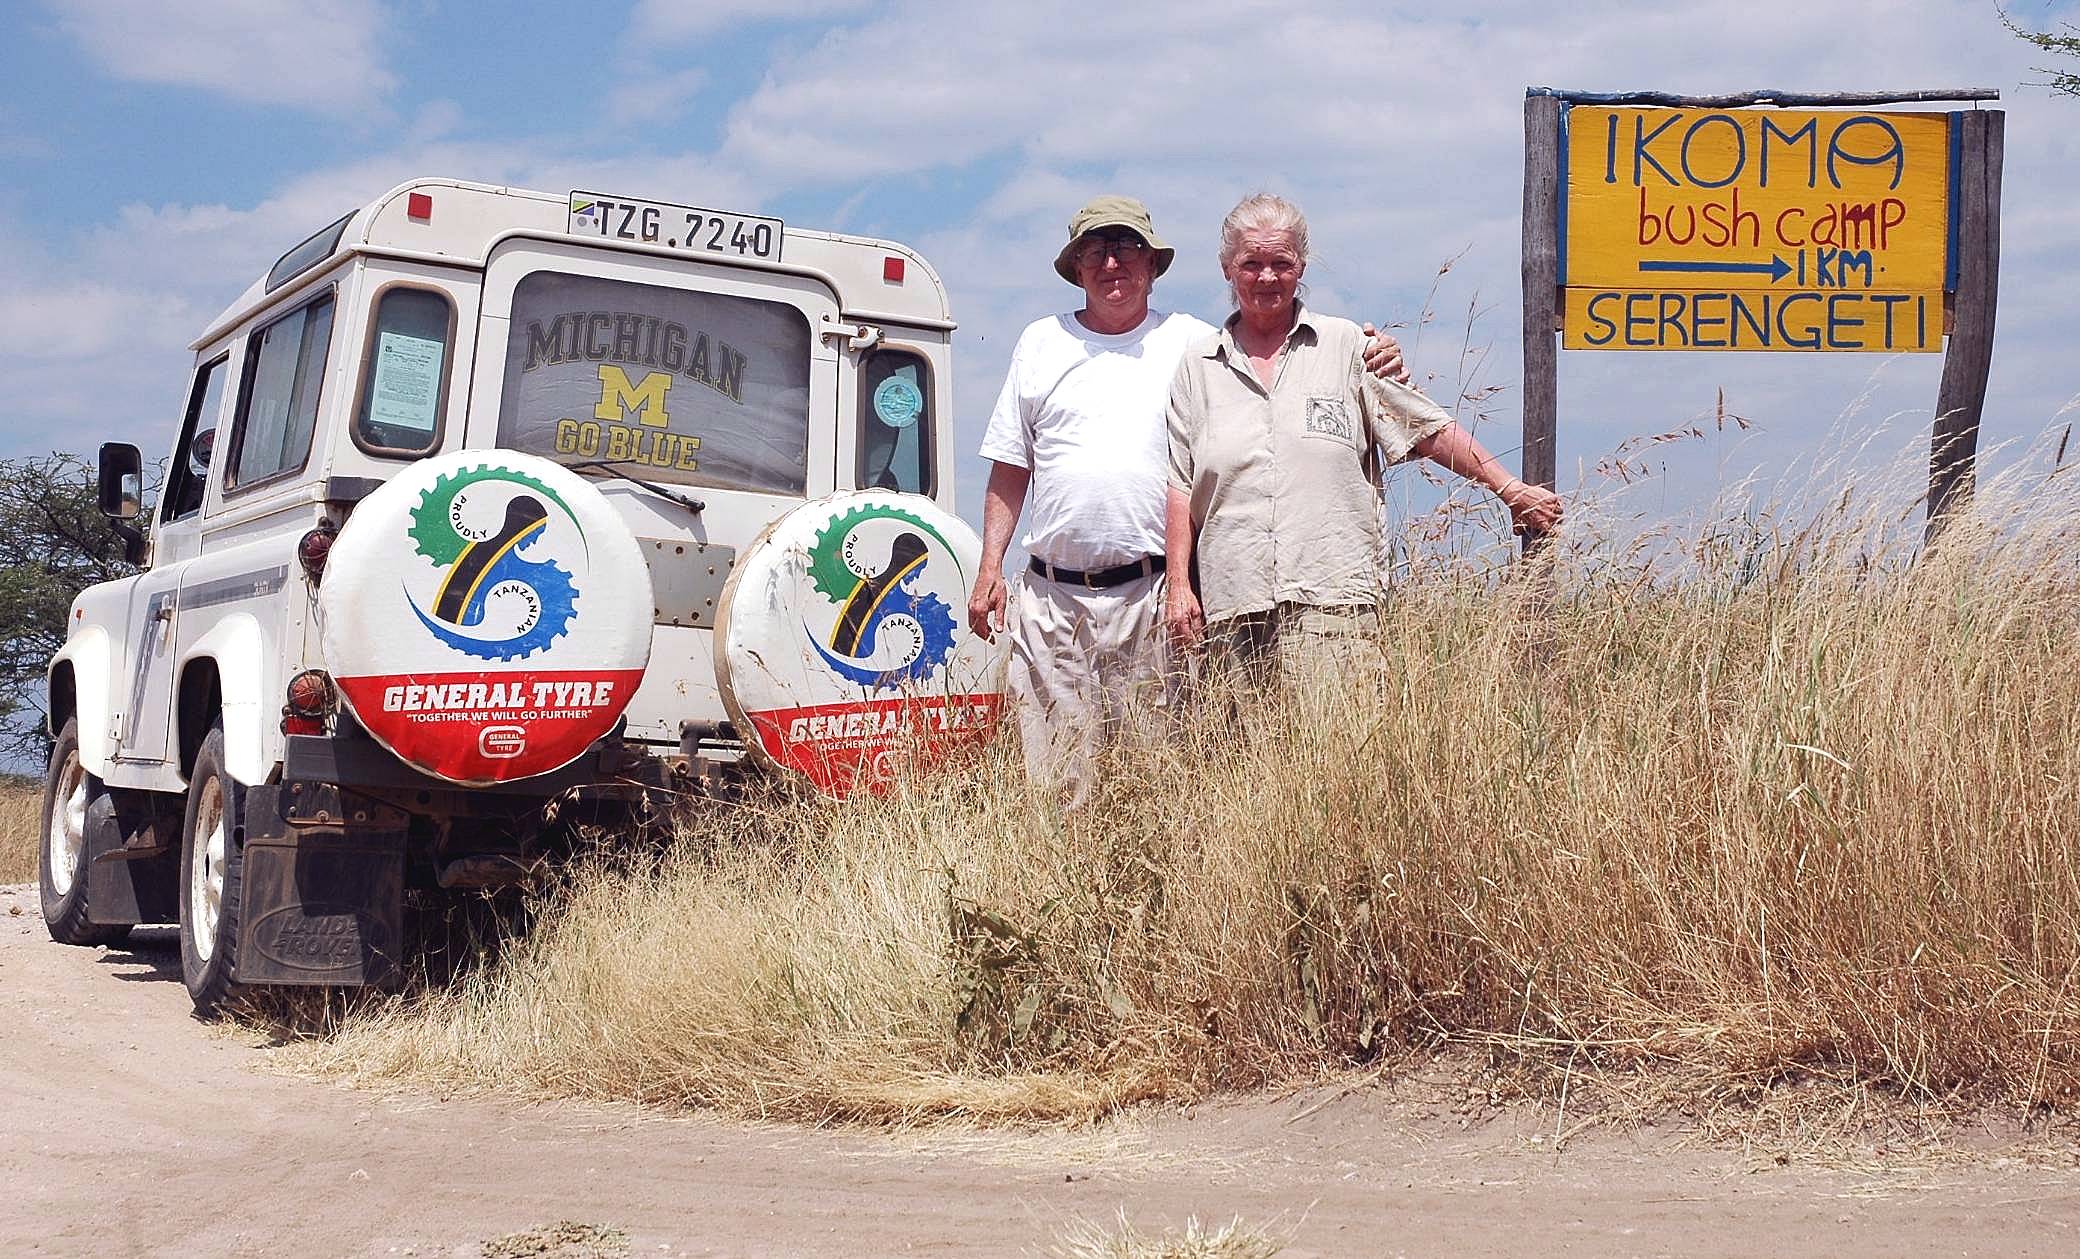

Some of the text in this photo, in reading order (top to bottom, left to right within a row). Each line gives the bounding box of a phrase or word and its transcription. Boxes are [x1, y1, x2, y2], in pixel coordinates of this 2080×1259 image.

[1604, 113, 1904, 190] IKOMA
[596, 200, 772, 257] TZG 7240
[1638, 186, 1760, 249] bush
[1583, 292, 1925, 349] SERENGETI
[522, 311, 748, 405] MICHIGAN
[594, 363, 673, 429] M
[554, 418, 701, 472] GO BLUE
[452, 495, 538, 634] PROUDLY TANZANIAN
[845, 534, 922, 664] PROUDLY TANZANIAN
[383, 681, 614, 712] GENERAL TYRE
[471, 711, 488, 721] WE
[492, 711, 518, 721] WILL
[522, 710, 538, 720] GO
[488, 733, 521, 741] GENERAL
